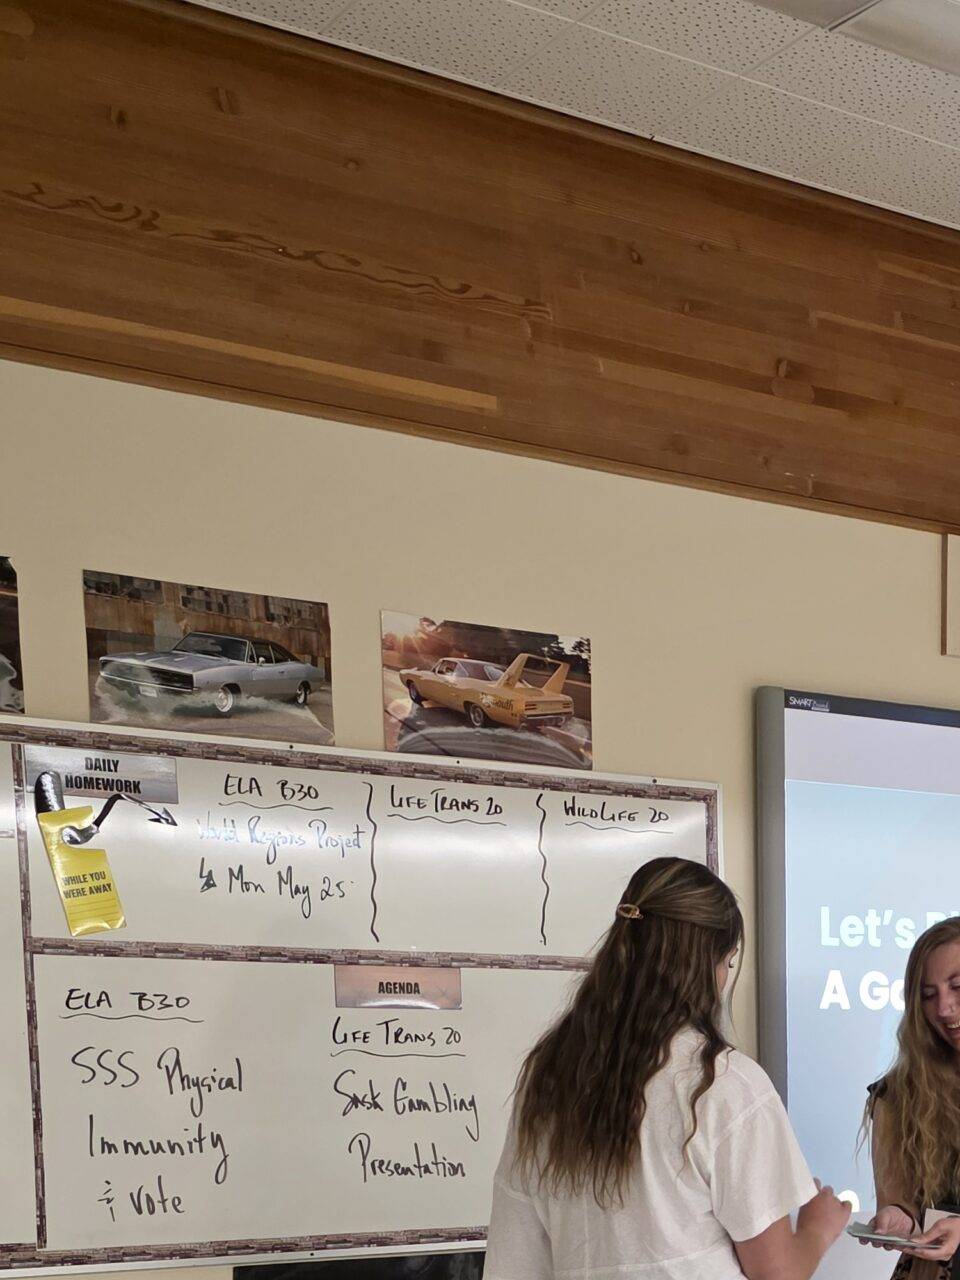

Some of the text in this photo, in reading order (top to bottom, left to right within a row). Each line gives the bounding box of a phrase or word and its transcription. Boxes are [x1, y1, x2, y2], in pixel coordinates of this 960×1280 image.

[85, 757, 119, 773] DAILY
[64, 776, 141, 794] HOMEWORK
[224, 773, 319, 801] ELA B30
[485, 800, 503, 815] 20
[649, 807, 669, 822] 20
[62, 871, 106, 887] WHILE YOU
[63, 883, 112, 899] WERE AWAY
[229, 864, 265, 893] Mon
[277, 866, 312, 918] May
[820, 906, 916, 948] Let's
[65, 988, 191, 1011] ELA B30
[378, 981, 420, 995] AGENDA
[819, 969, 850, 1010] A
[443, 1026, 461, 1044] 20
[71, 1046, 243, 1118] SSS Physical
[393, 1077, 480, 1142] Gambling
[89, 1114, 229, 1185] Immunity
[348, 1132, 466, 1184] Presentation
